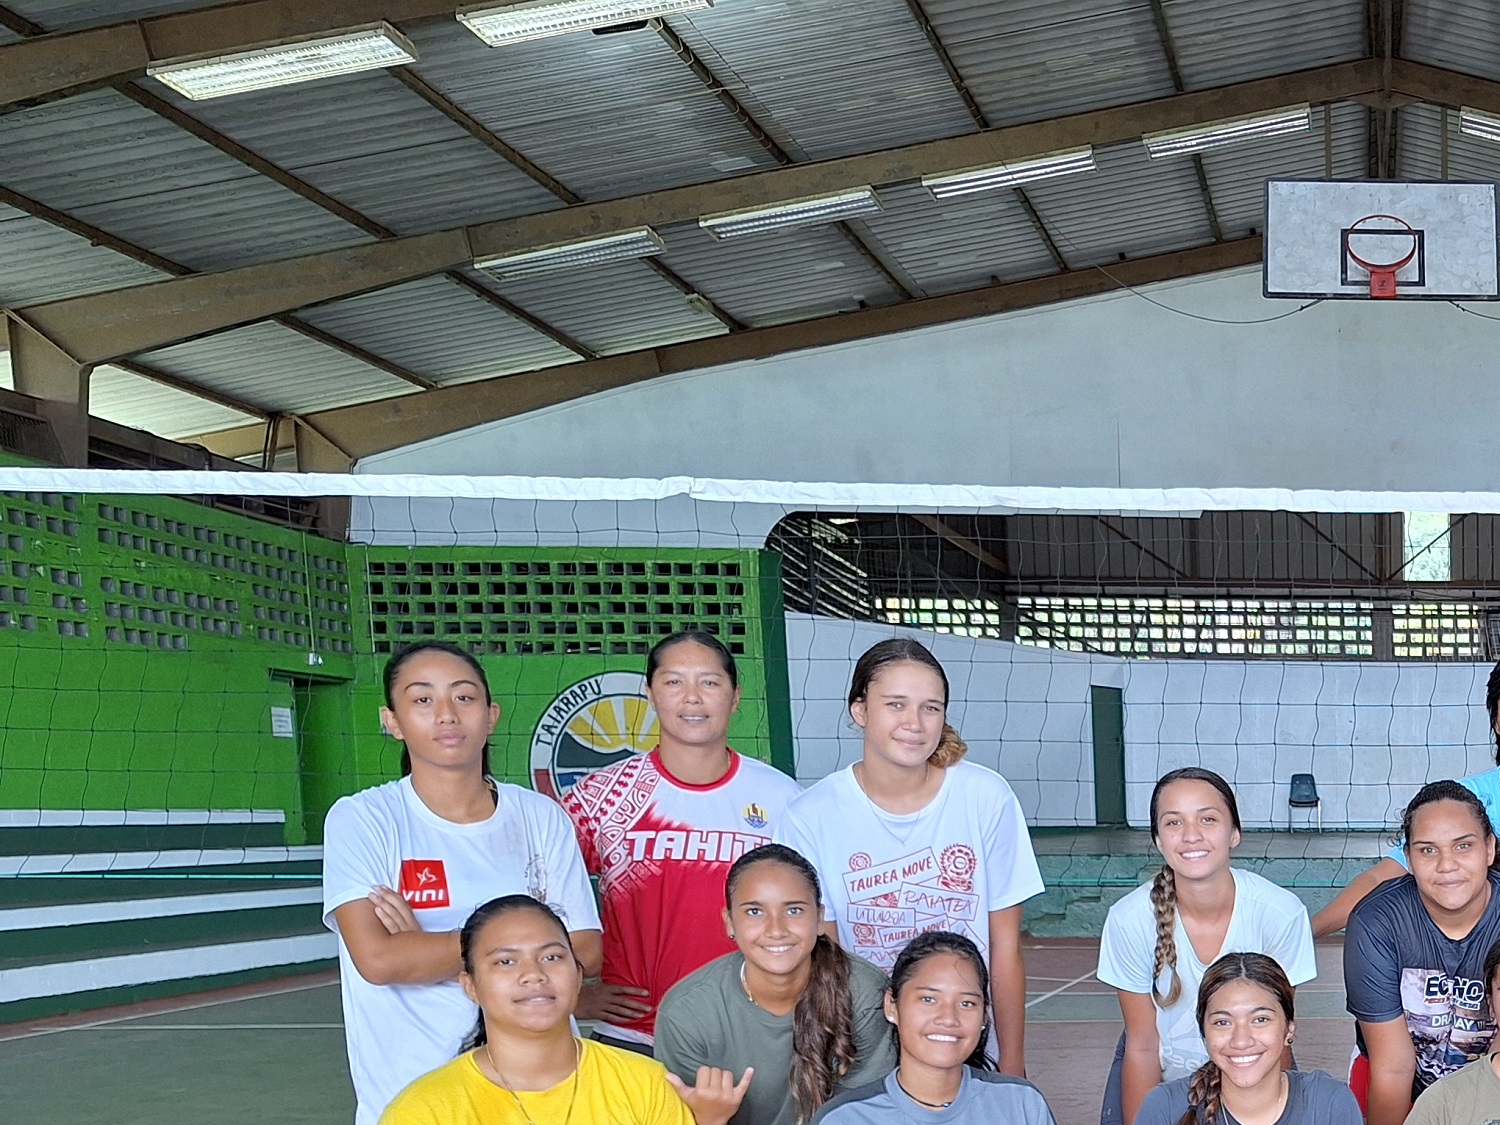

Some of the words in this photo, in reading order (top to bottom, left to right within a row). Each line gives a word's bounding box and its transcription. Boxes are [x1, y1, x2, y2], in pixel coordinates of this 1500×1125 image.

[535, 679, 602, 747] TAIARAPU
[625, 830, 772, 862] TAHIT
[850, 869, 898, 893] TAUREA
[902, 856, 933, 879] MOVE
[855, 908, 906, 926] UTUROA
[904, 890, 975, 915] RAIATEA
